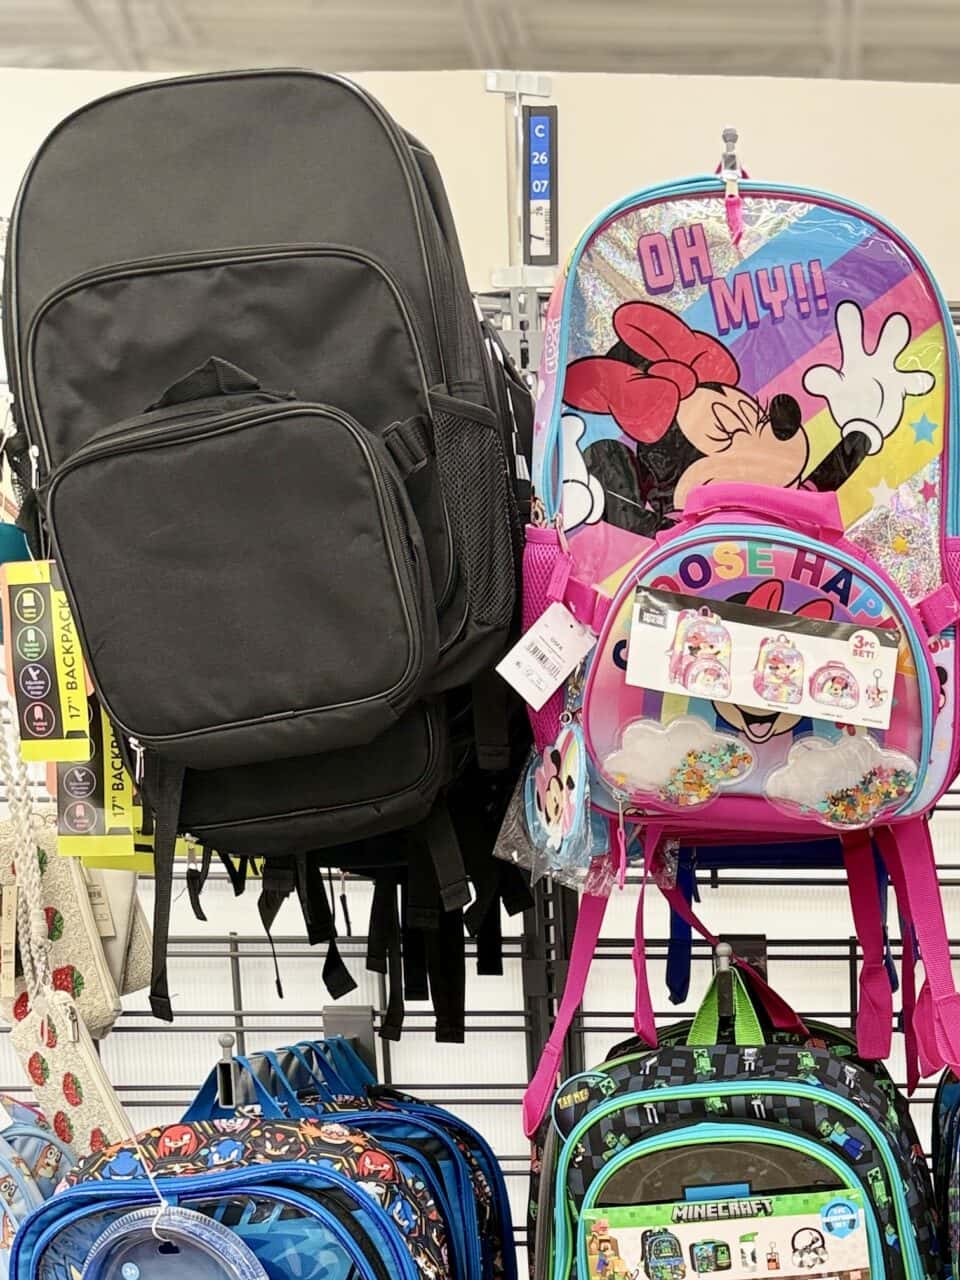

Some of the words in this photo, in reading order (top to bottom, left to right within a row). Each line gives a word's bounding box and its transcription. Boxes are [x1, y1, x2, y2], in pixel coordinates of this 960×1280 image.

[534, 125, 545, 138] C
[531, 152, 549, 165] 26
[532, 180, 549, 193] 07
[637, 223, 714, 295] OH
[710, 259, 829, 336] MY!!
[60, 598, 80, 692] BACKPACK
[671, 1198, 774, 1224] MINECRAFT
